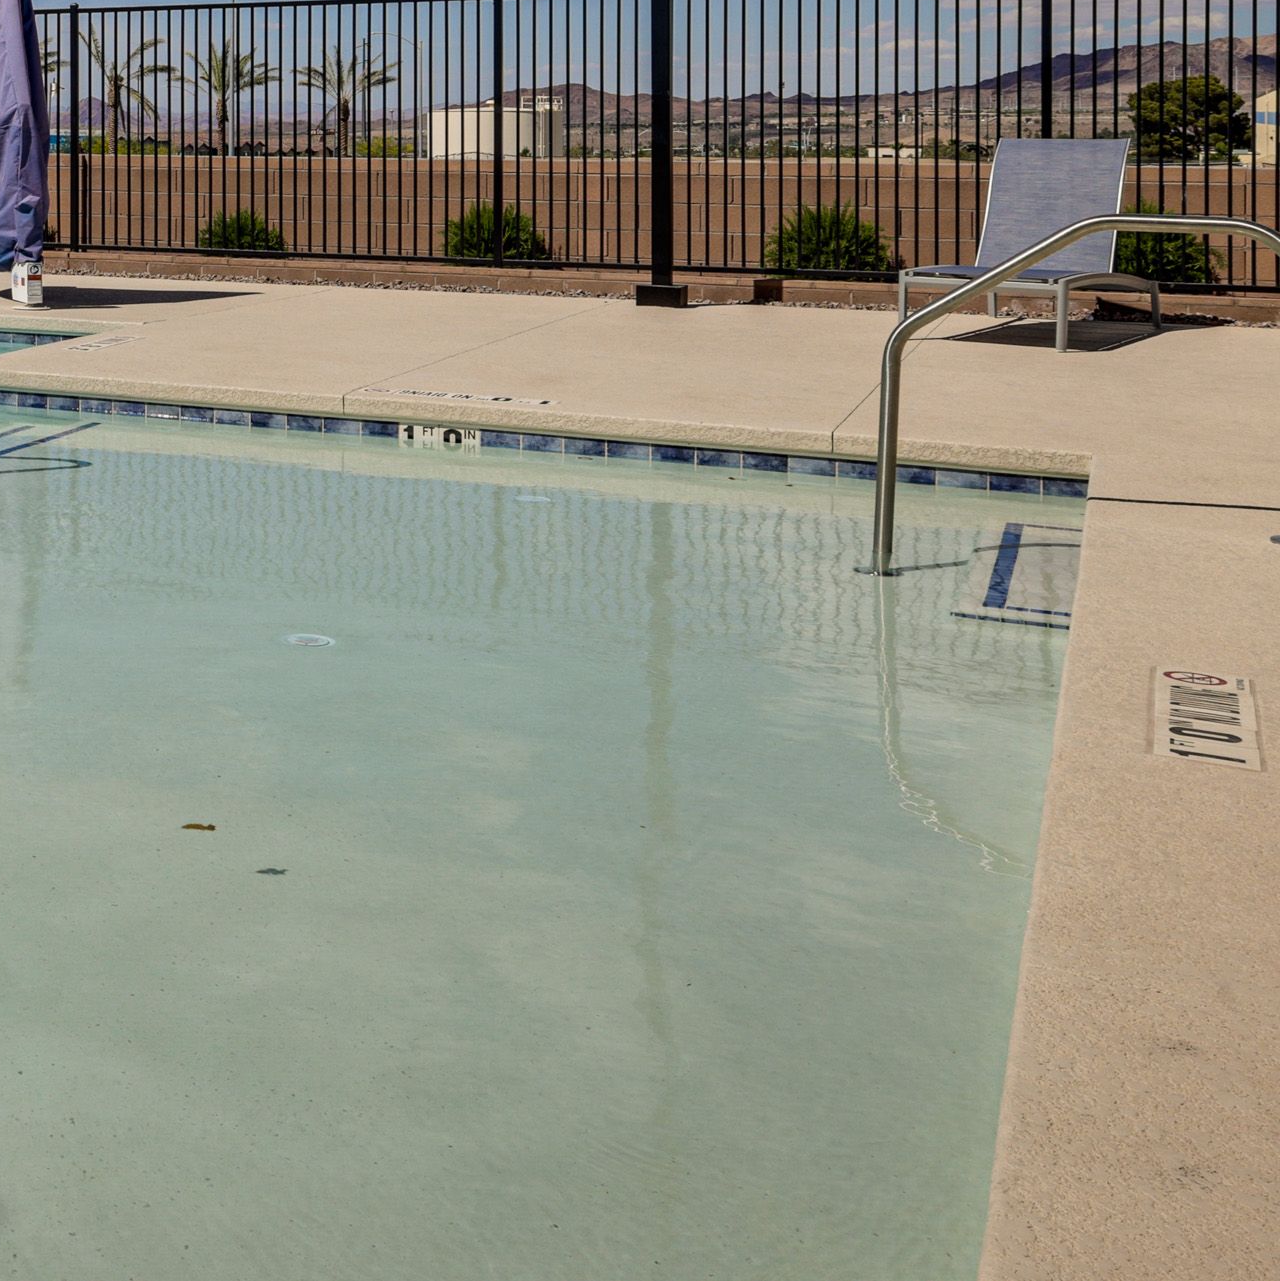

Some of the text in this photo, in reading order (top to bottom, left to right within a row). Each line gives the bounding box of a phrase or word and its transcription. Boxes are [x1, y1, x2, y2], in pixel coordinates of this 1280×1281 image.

[403, 425, 414, 439] 1
[423, 427, 435, 437] FT
[464, 429, 476, 440] IN
